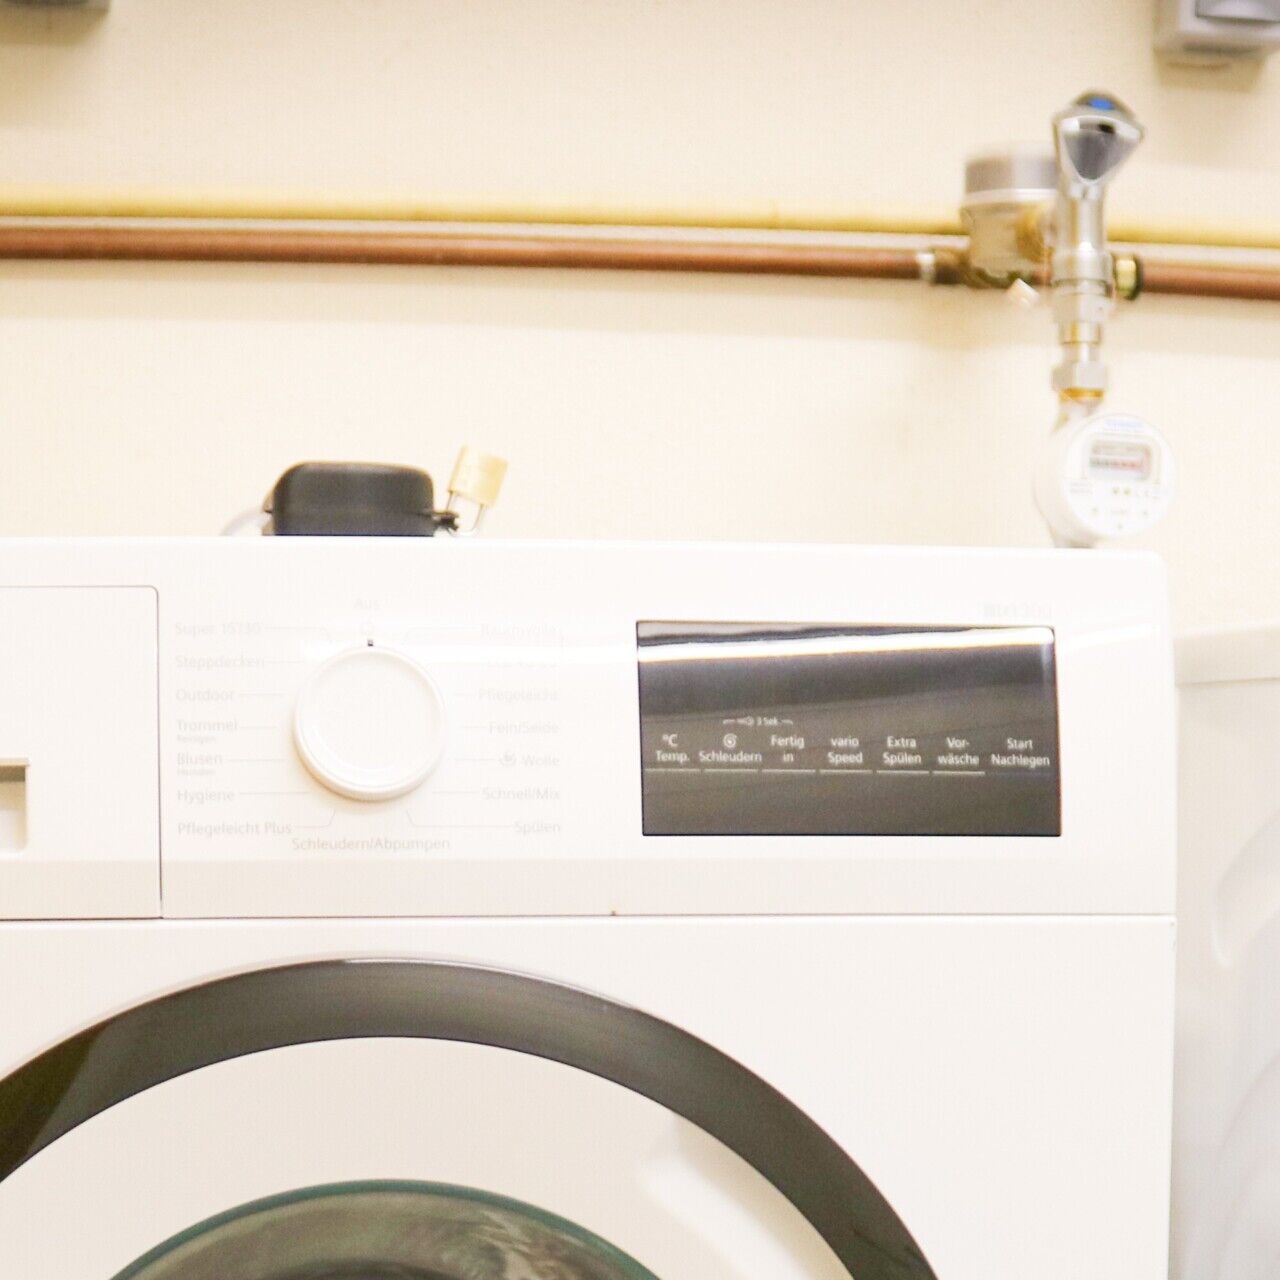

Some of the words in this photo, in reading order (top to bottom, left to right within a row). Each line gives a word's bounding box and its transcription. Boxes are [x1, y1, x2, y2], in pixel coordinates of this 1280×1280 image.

[176, 688, 235, 702] Outdoor
[177, 719, 238, 733] Trommel
[771, 734, 805, 750] Fertig
[831, 735, 860, 748] vario
[887, 736, 917, 749] Extra
[946, 737, 970, 749] Vor-
[1007, 738, 1033, 750] Start
[177, 752, 223, 766] Blusen
[655, 750, 690, 764] Temp.
[699, 750, 763, 762] Schleudern
[783, 750, 795, 762] in
[827, 752, 863, 765] Speed
[882, 752, 922, 766] Spülen
[938, 754, 980, 766] wäsche
[991, 754, 1050, 768] Nachlegen
[177, 788, 235, 805] Hygiene
[178, 821, 260, 838] Pflegeleicht
[265, 821, 293, 835] Plus
[292, 837, 450, 852] Schleudern/Abpumpen
